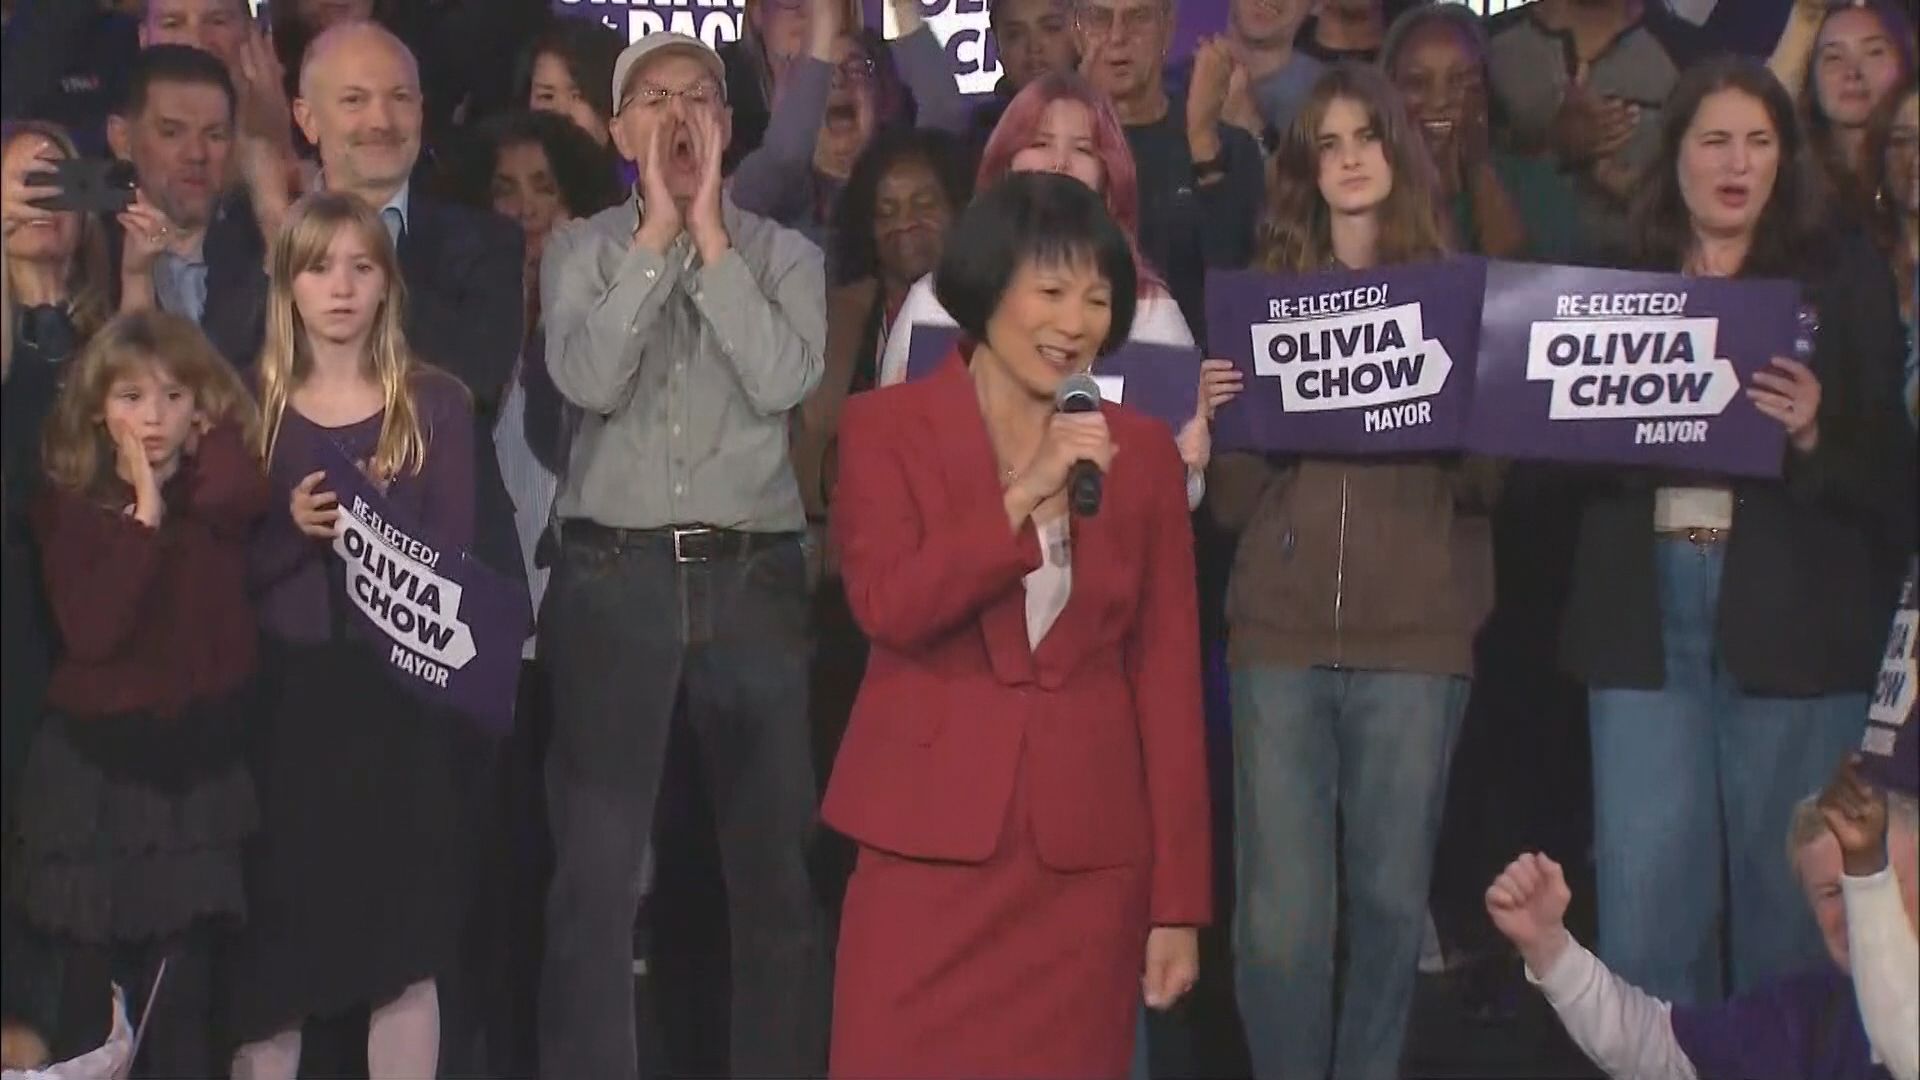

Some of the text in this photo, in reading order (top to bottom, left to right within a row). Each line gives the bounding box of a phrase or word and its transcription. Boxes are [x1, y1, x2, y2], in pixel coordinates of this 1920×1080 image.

[1269, 283, 1388, 318] RE-ELECTED!
[1556, 292, 1688, 316] RE-ELECTED!
[1268, 319, 1406, 364] OLIVIA
[1546, 331, 1695, 366] OLIVIA
[1295, 354, 1425, 400] CHOW
[1569, 372, 1713, 406] CHOW
[1364, 401, 1431, 432] MAYOR
[1635, 421, 1708, 444] MAYOR
[352, 495, 440, 568] RE-ELECTED!
[343, 527, 441, 615] OLIVIA
[355, 575, 455, 652] CHOW
[390, 645, 449, 688] MAYOR
